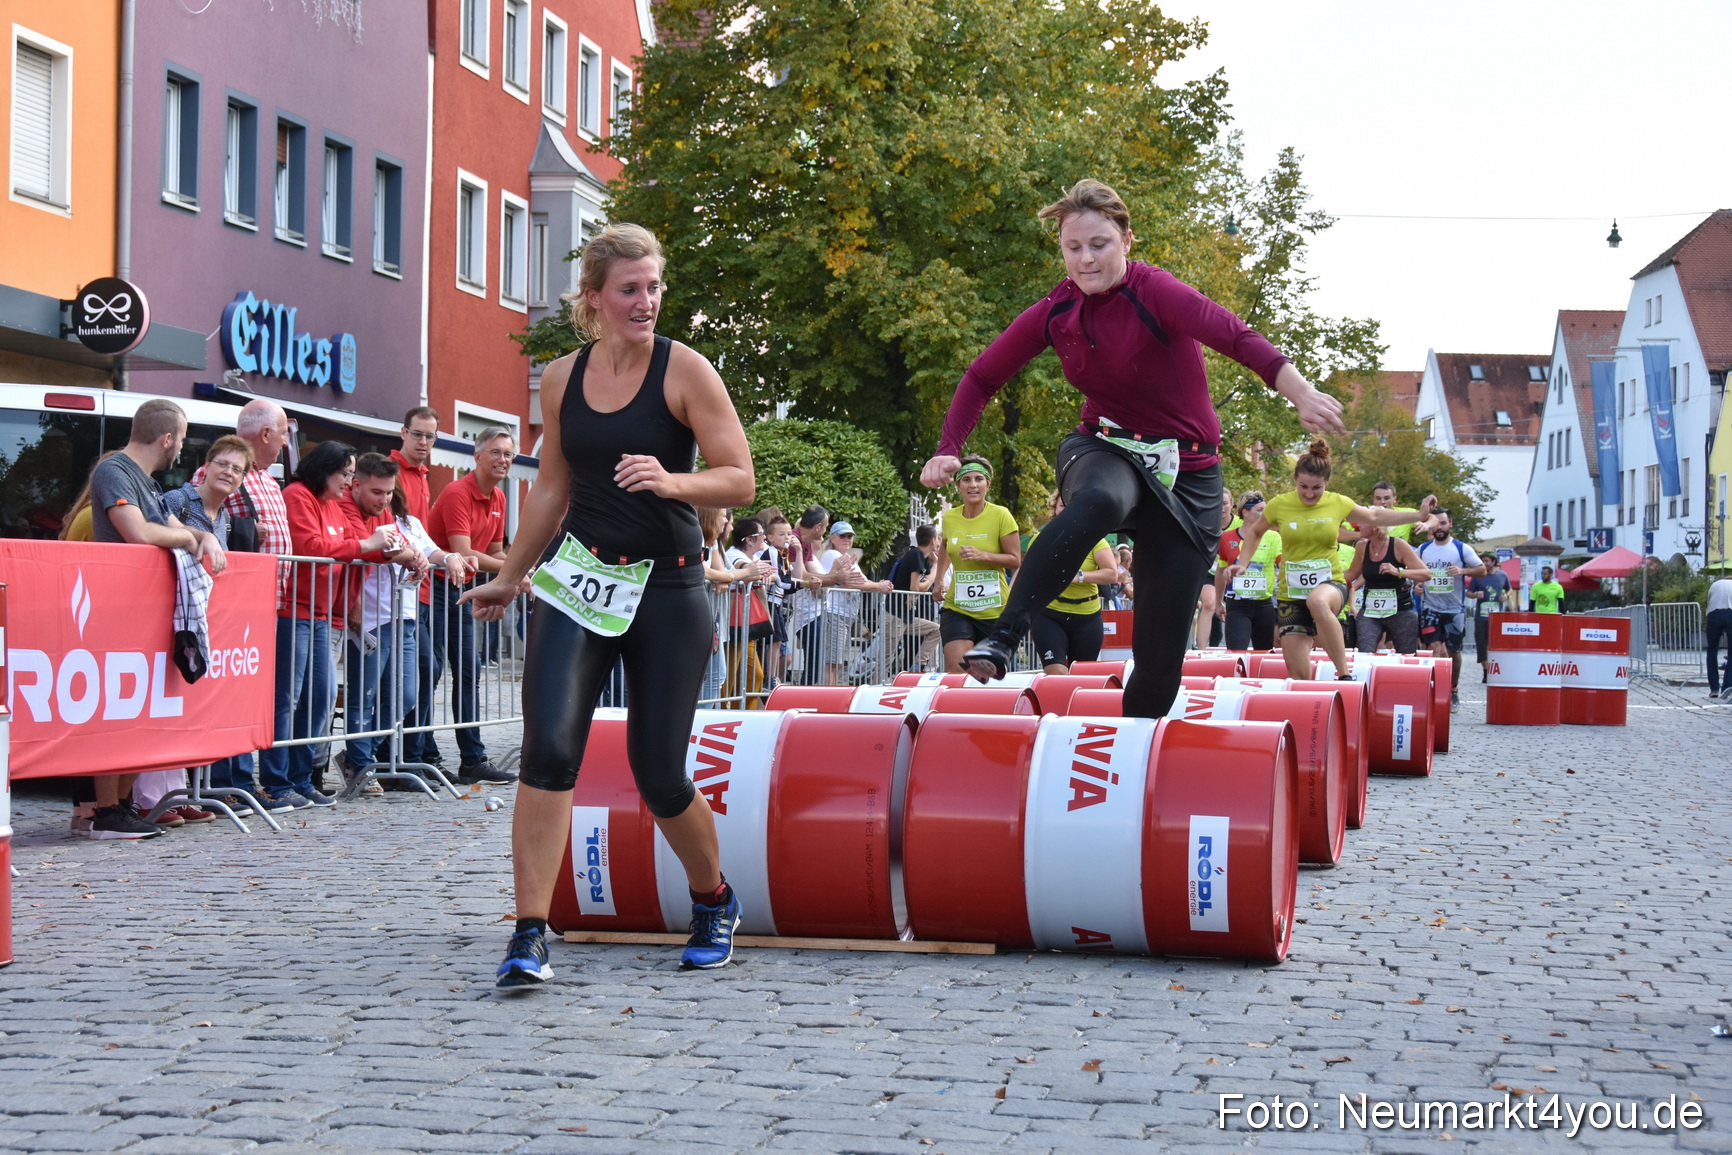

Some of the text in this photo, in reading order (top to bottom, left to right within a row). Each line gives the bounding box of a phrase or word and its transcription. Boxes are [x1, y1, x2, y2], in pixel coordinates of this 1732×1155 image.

[78, 324, 137, 336] hunkemöller
[231, 290, 333, 388] Eilles
[957, 572, 997, 582] BOCK
[1243, 579, 1257, 588] 87
[1300, 573, 1318, 586] 66
[1432, 577, 1448, 586] 138
[570, 574, 618, 608] 101
[967, 584, 986, 598] 62
[556, 587, 604, 625] SONJA
[959, 598, 996, 608] CORNELIA
[1373, 599, 1387, 608] 67
[600, 828, 608, 867] energie
[1189, 880, 1198, 916] energie
